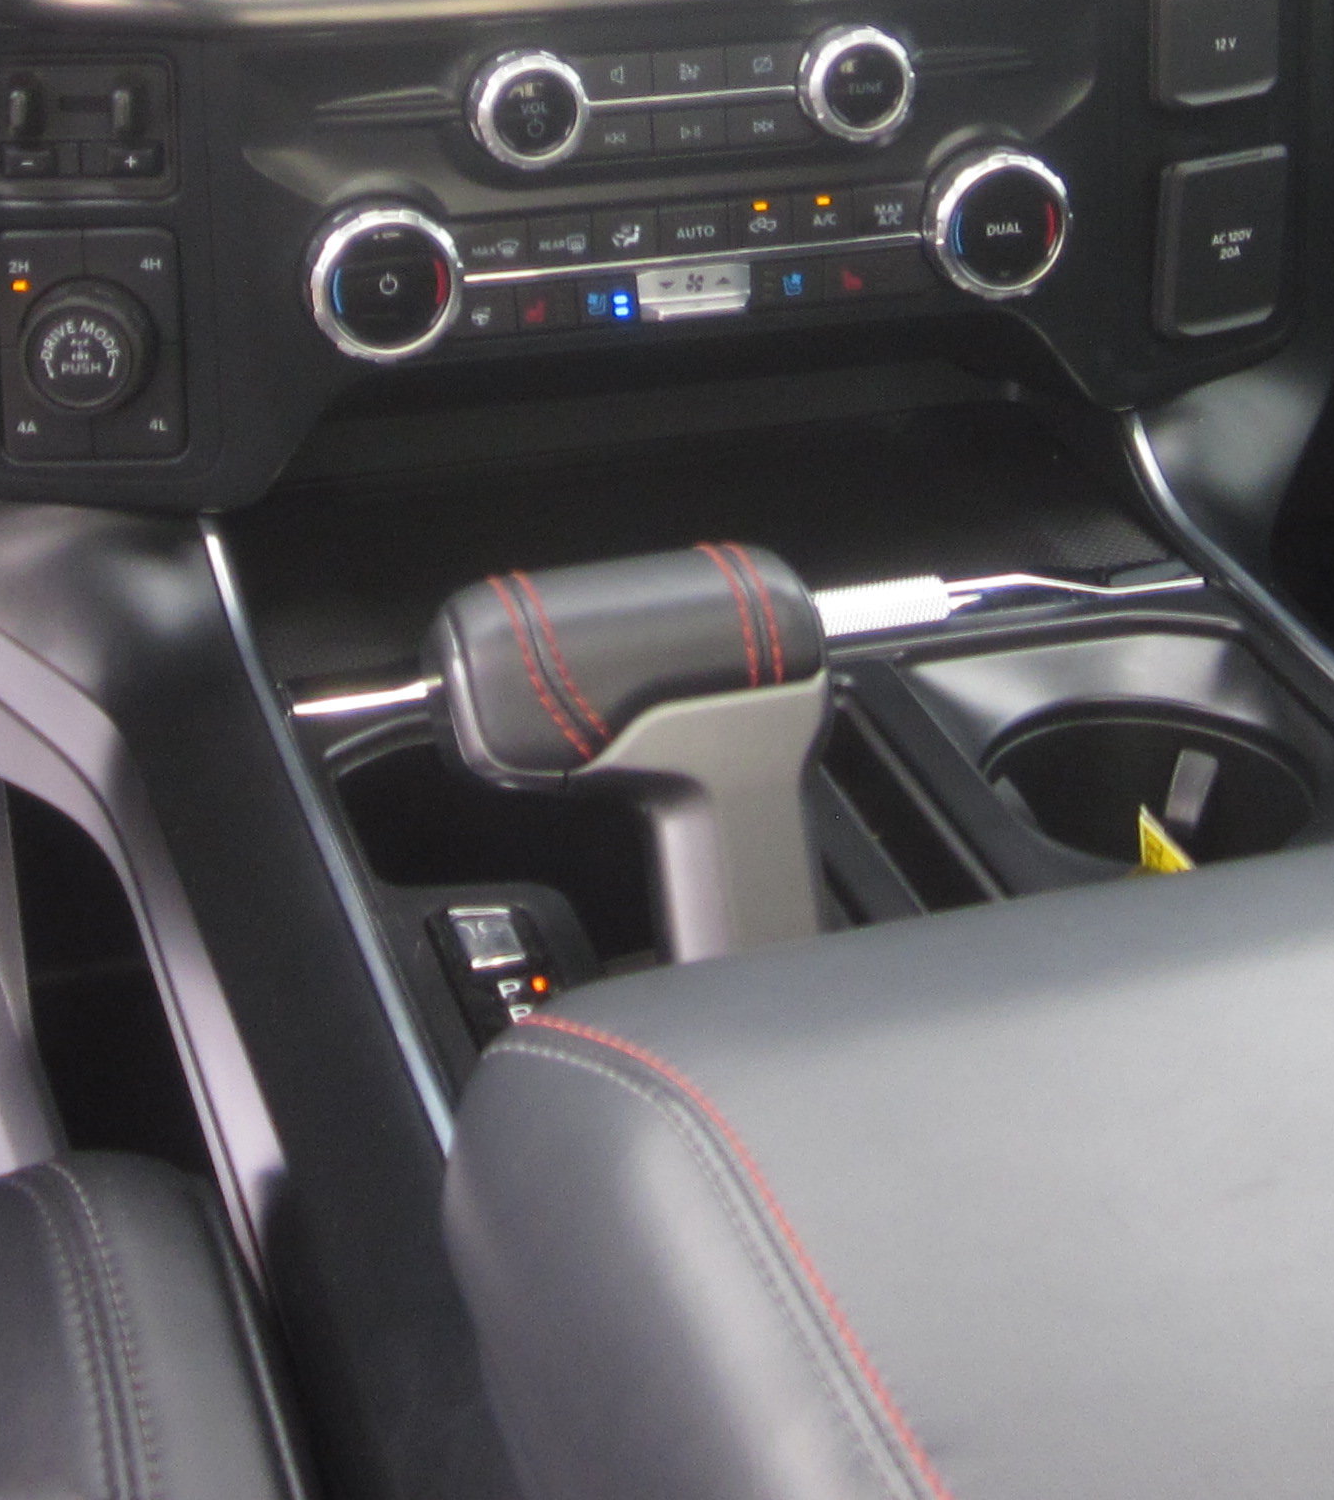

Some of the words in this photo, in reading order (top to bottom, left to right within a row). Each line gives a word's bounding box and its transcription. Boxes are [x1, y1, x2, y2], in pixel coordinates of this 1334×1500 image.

[847, 80, 884, 96] TUNE
[519, 101, 547, 115] VOL
[812, 213, 837, 226] A/C
[676, 225, 716, 240] AUTO
[985, 222, 1022, 237] DUAL
[8, 260, 30, 273] 2H
[139, 257, 162, 271] 4H
[40, 320, 76, 361] DRIVE
[79, 318, 122, 360] MODE
[60, 362, 102, 375] PUSH
[17, 421, 38, 435] 4A
[149, 418, 167, 432] 4L
